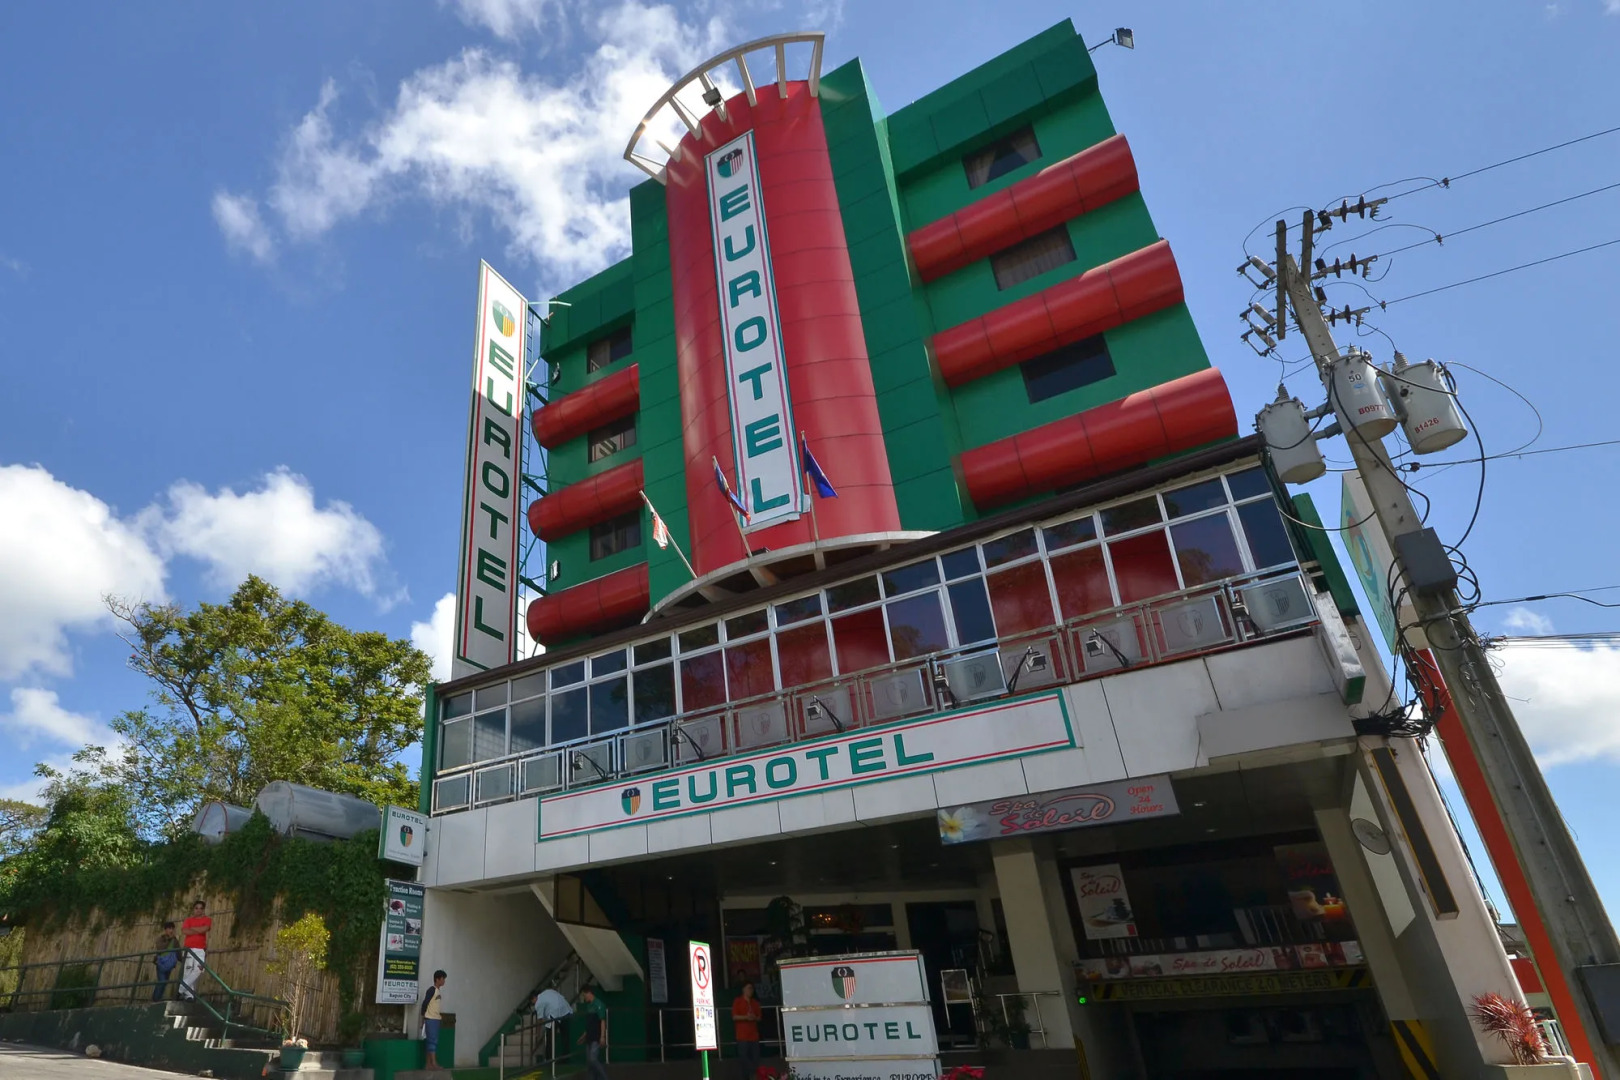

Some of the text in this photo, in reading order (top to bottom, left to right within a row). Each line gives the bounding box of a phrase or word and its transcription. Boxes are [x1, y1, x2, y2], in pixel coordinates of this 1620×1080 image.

[720, 184, 791, 514] EUROTEL
[1348, 373, 1362, 383] 50
[1414, 417, 1439, 434] B1426
[474, 338, 515, 642] EUROTEL
[652, 733, 935, 812] EUROTEL
[1127, 785, 1154, 796] Open
[1139, 796, 1151, 804] 24
[989, 799, 1037, 815] Spa
[1000, 793, 1115, 835] Soleil
[1023, 808, 1044, 819] de
[1130, 804, 1163, 815] Hours
[392, 811, 423, 825] EUROTEL
[1080, 875, 1121, 898] Soleil
[1221, 949, 1264, 972] Soleil
[1121, 973, 1331, 996] VERTICAL CLEARANCE 2.0 METERS
[791, 1021, 922, 1043] EUROTEL
